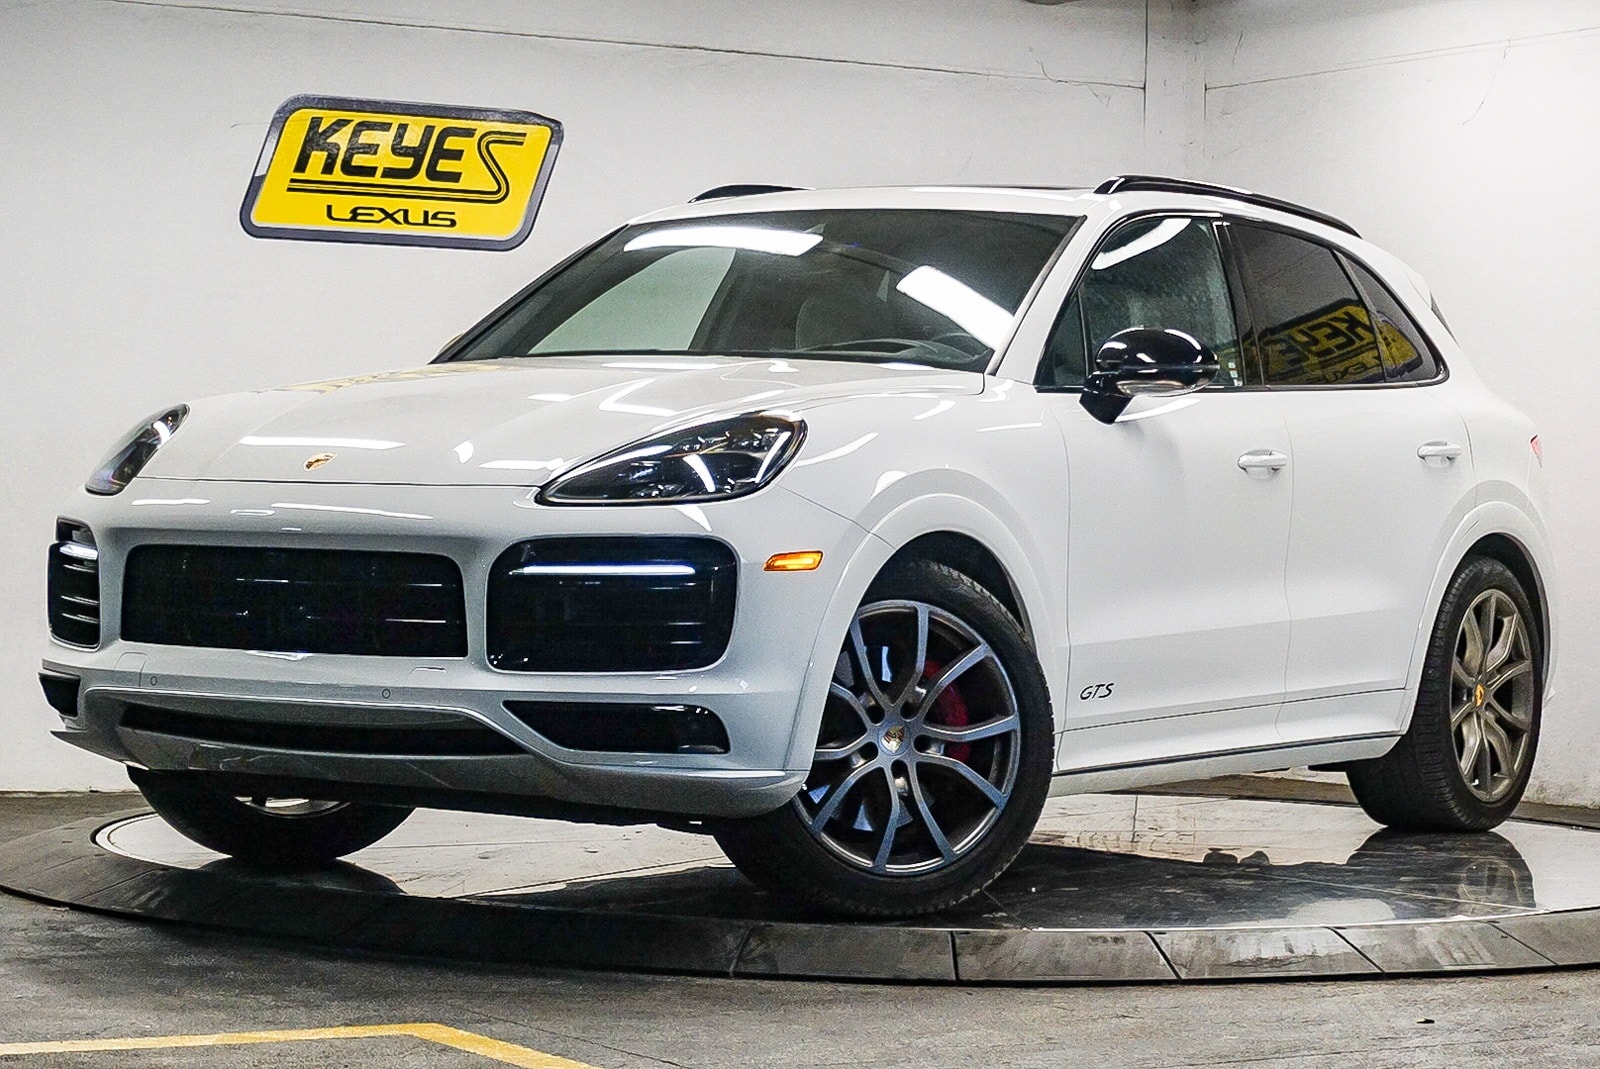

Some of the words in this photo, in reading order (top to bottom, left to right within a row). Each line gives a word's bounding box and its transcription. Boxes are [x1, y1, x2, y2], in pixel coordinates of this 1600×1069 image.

[288, 116, 527, 203] KEYES
[326, 204, 457, 228] LEXUS
[1080, 682, 1114, 700] GTS
